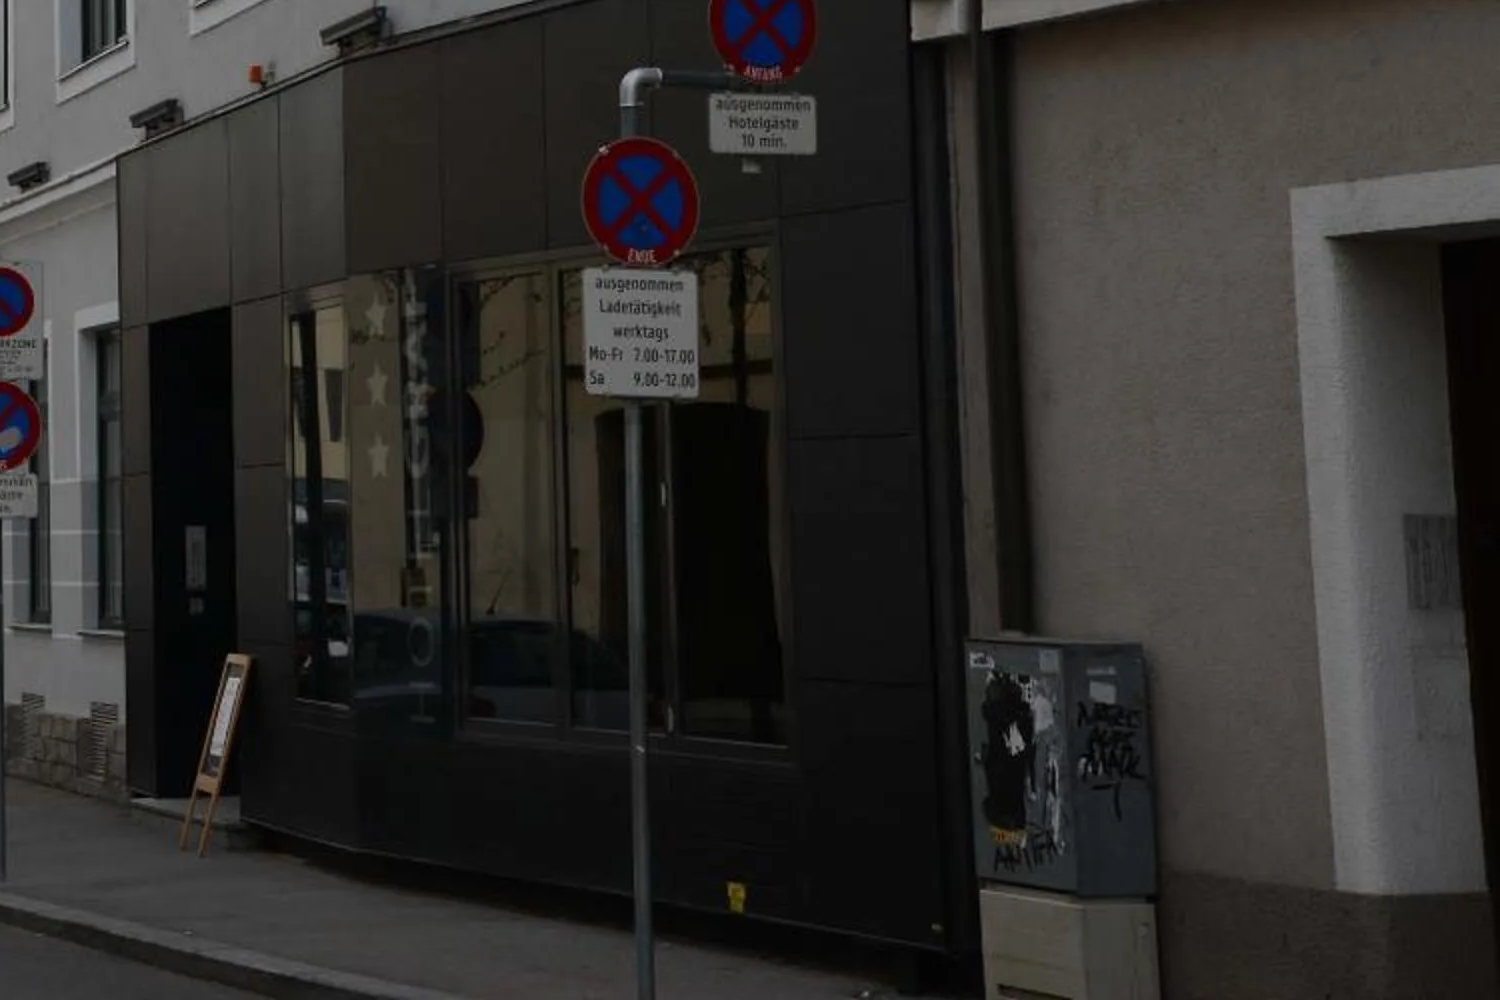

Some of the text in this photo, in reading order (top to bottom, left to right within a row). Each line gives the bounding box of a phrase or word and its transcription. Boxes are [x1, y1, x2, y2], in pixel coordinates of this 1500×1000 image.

[715, 98, 811, 113] ausgenommen
[728, 115, 800, 132] Hotelgäste
[741, 134, 788, 148] 10 min.
[627, 247, 657, 263] ENDE
[595, 277, 684, 293] ausgenommen
[599, 299, 682, 318] Ladetätigkeit
[613, 326, 670, 343] werktags
[589, 345, 695, 364] Mo-Fr 7.00-17.00
[589, 369, 695, 388] Sa 9.00-12.00
